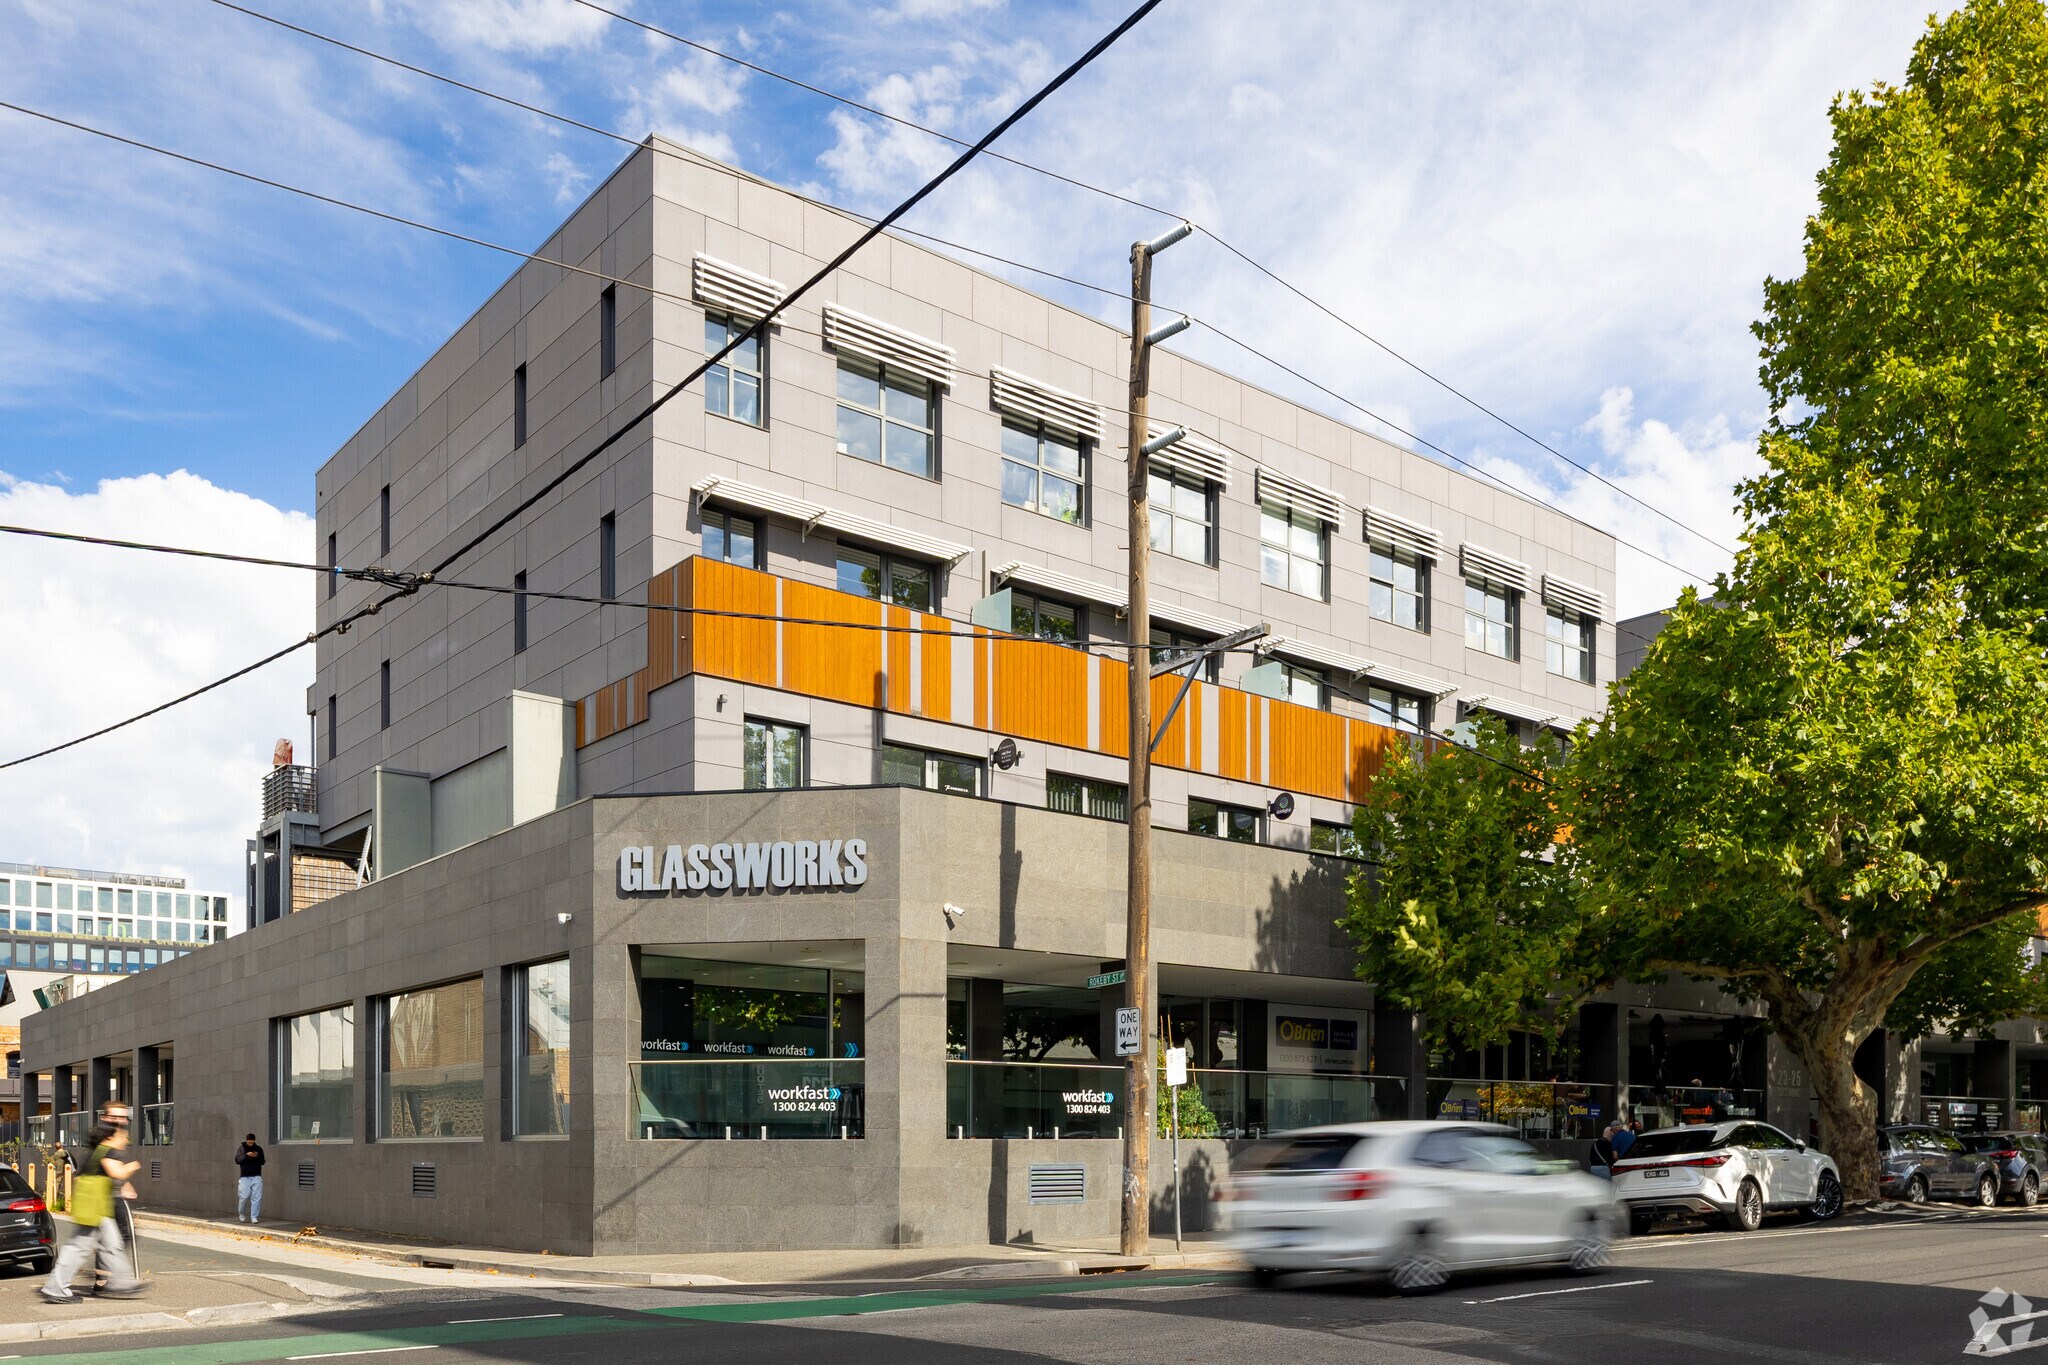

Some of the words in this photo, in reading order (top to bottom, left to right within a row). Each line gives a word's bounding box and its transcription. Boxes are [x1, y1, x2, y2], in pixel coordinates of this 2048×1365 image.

[620, 838, 868, 892] GLASSWORKS
[1089, 974, 1111, 987] ROKEBY
[1112, 973, 1119, 983] ST
[1120, 1012, 1137, 1024] ONE
[1119, 1026, 1138, 1038] WAY
[704, 1042, 746, 1054] workfast
[768, 1045, 807, 1057] workfast
[1778, 1070, 1801, 1087] 23-25
[768, 1085, 829, 1100] workfast
[1062, 1089, 1106, 1103] workfast
[773, 1101, 796, 1112] 1300
[798, 1101, 816, 1112] 824
[818, 1101, 836, 1112] 403
[1066, 1104, 1083, 1114] 1300
[1084, 1105, 1097, 1114] 824
[1097, 1105, 1111, 1114] 403
